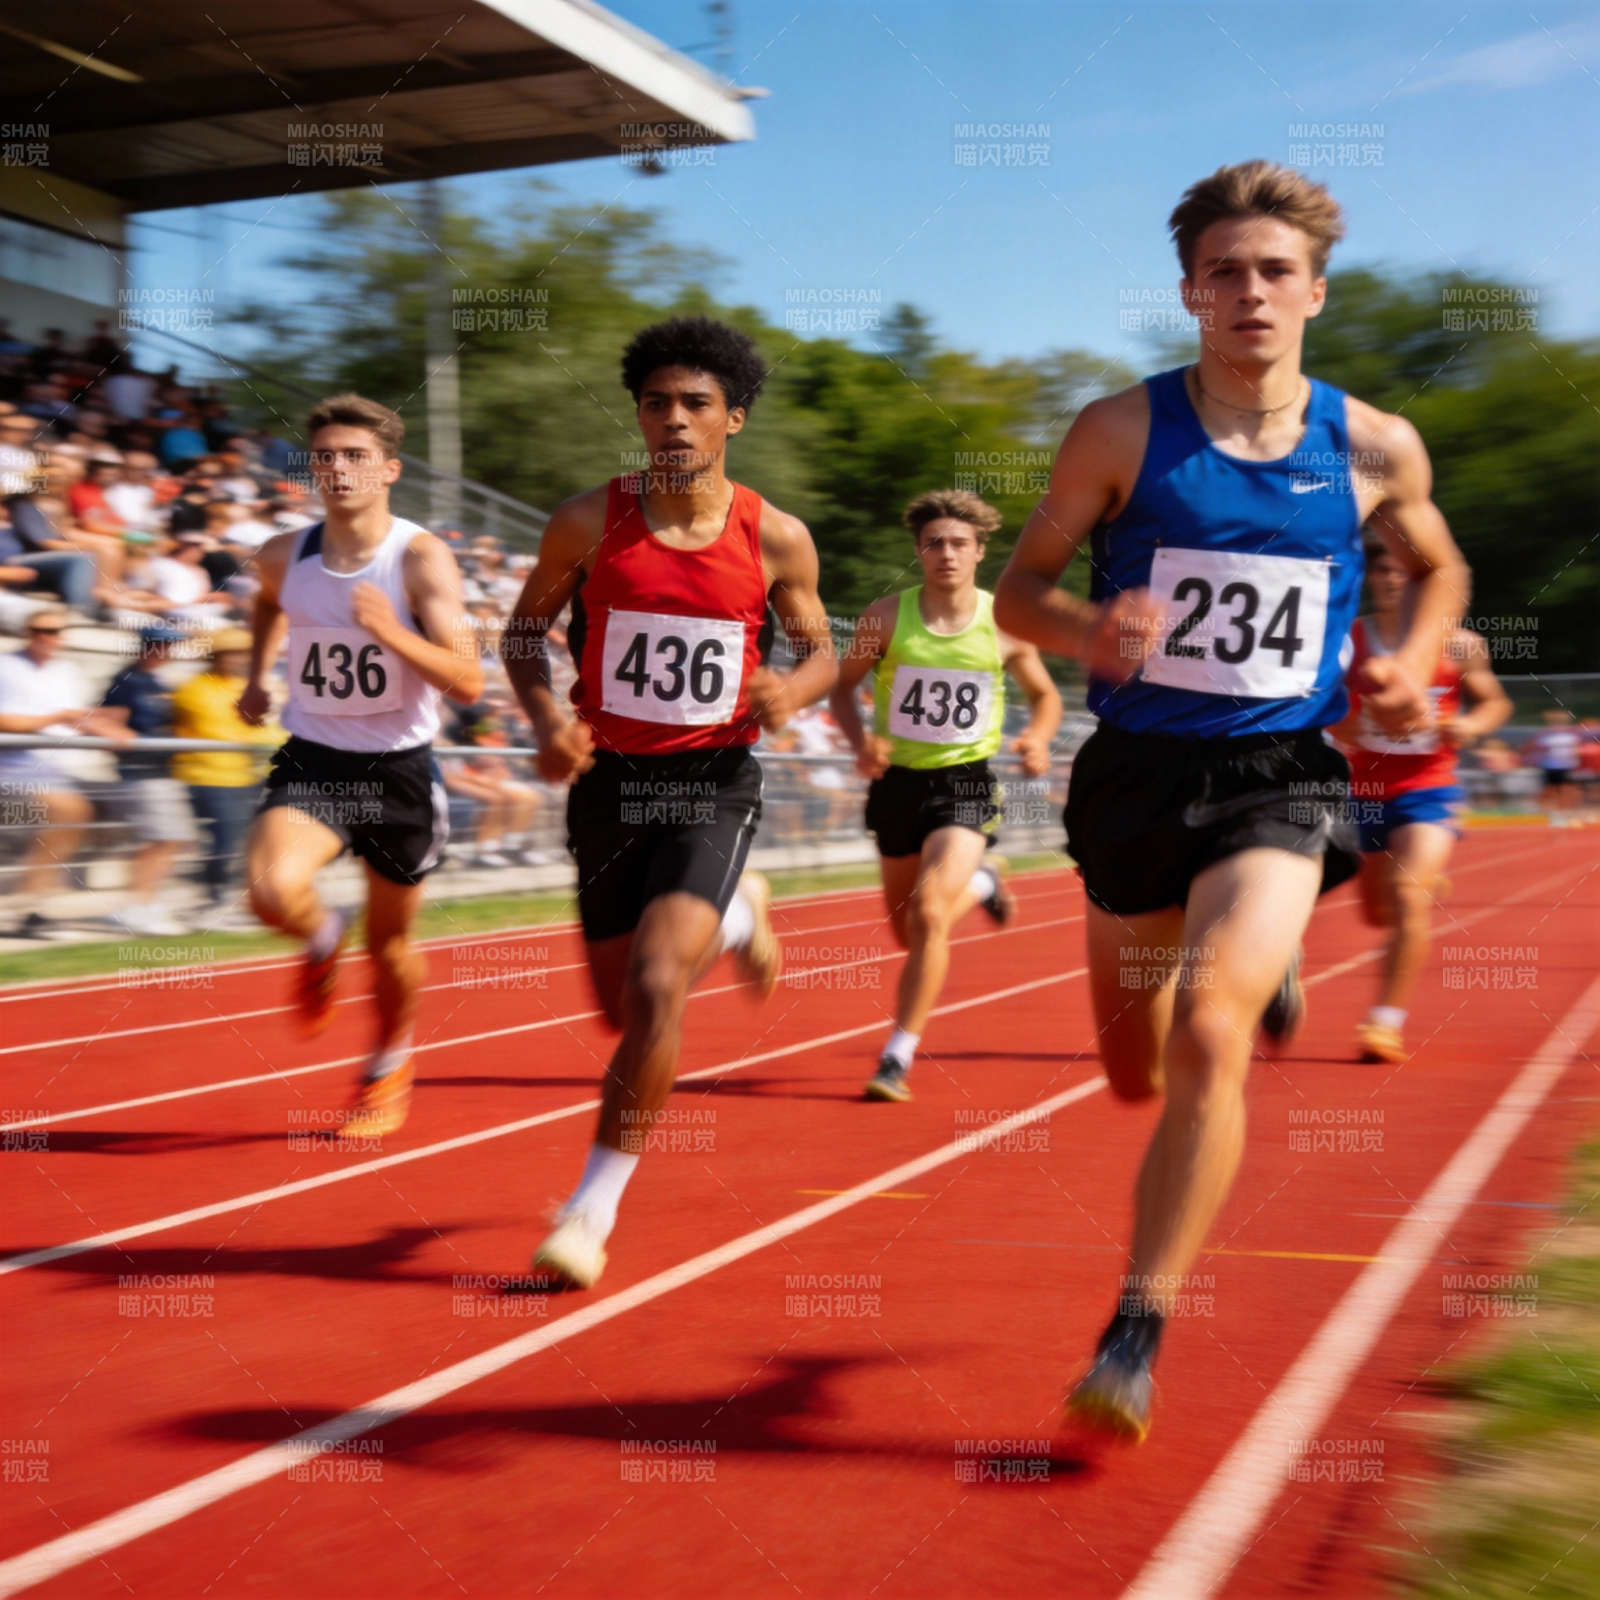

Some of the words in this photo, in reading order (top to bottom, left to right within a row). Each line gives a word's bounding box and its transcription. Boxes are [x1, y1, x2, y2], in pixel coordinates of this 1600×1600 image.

[1164, 577, 1303, 668] 234
[301, 642, 386, 699] 436
[615, 632, 725, 704] 436
[899, 678, 979, 729] 438
